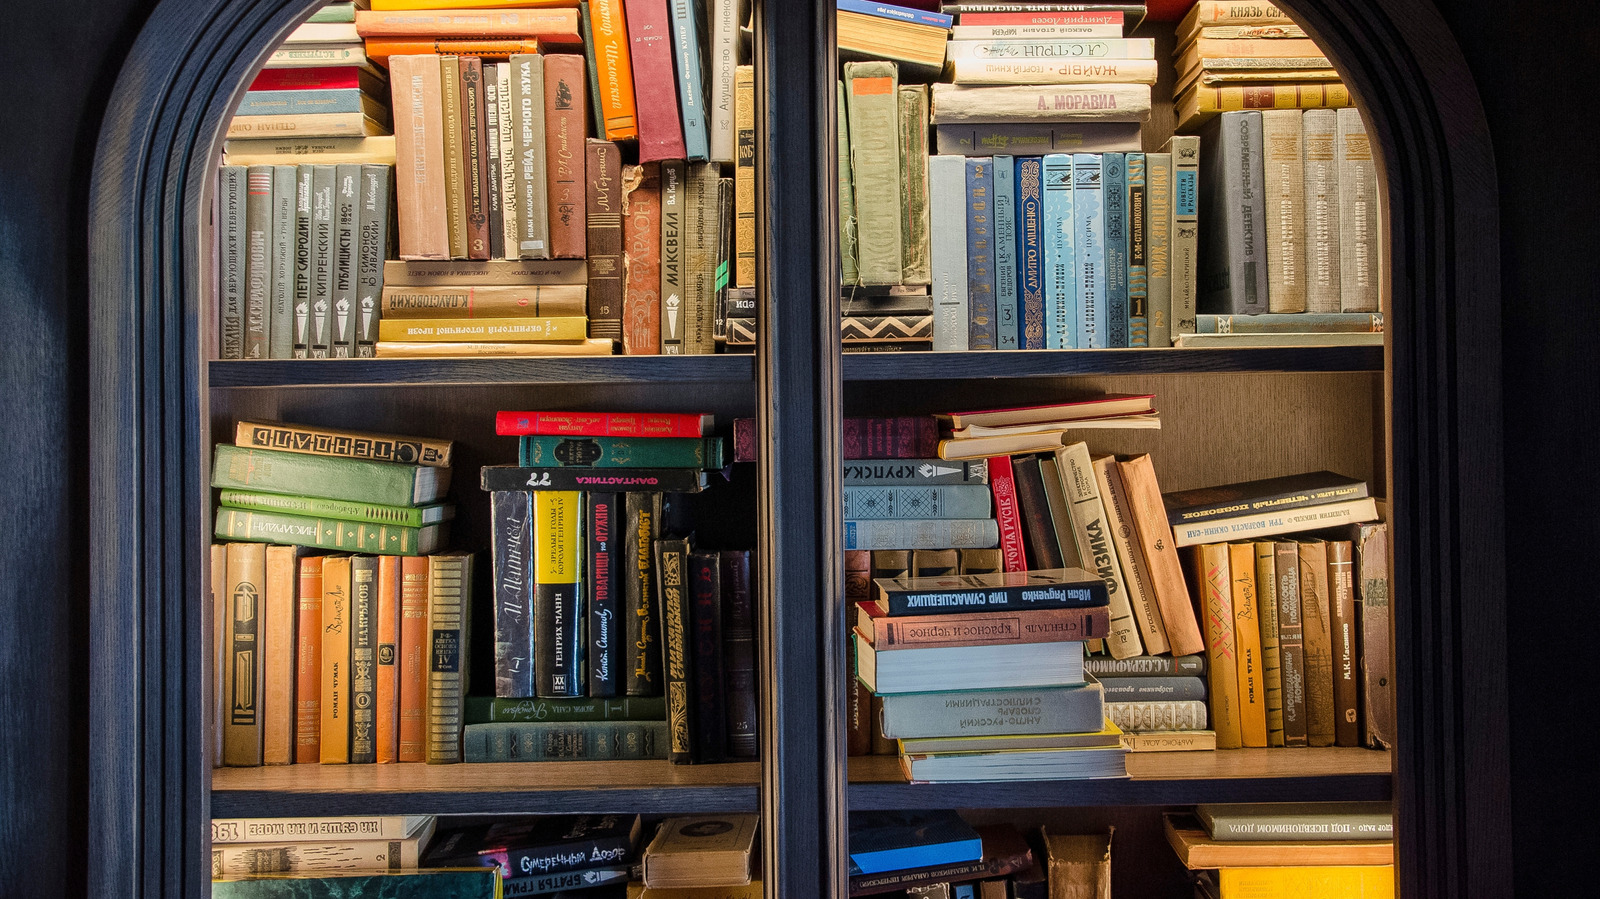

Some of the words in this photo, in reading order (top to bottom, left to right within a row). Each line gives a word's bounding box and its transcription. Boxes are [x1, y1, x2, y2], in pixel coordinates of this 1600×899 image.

[600, 0, 613, 35] иктор
[721, 0, 730, 33] гинеко
[1031, 16, 1060, 25] Лосев
[1063, 14, 1113, 25] Дмитрий
[605, 41, 622, 109] Шкловский
[985, 64, 1011, 72] КНИШ
[1058, 64, 1118, 77] ЖАЙВІР
[520, 61, 531, 95] ЖУКА
[719, 49, 731, 111] Акушерство
[500, 78, 512, 142] ПЕДАГОГІКА
[1037, 94, 1047, 111] А.
[1053, 94, 1117, 110] МОРАВИА
[522, 98, 533, 147] ЧЕРНОГО
[522, 149, 535, 179] РЕЙД
[1239, 120, 1254, 199] СОВРЕМЕННЫЙ
[229, 172, 237, 232] НЕВЕРУЮЩИХ
[526, 184, 534, 217] МАКАРОВ
[997, 199, 1006, 260] КАМЕННЫЙ
[1005, 216, 1013, 241] ПОЯС
[1026, 201, 1037, 246] МІЩЕНКО
[1151, 165, 1168, 278] МИХ.ЗОЩЕНКО
[1243, 205, 1254, 255] ДЕТЕКТИВ
[297, 217, 309, 271] СМОРОДИН
[361, 225, 370, 273] СИМОНОВ
[369, 220, 379, 273] ЗАВАДСКИЙ
[473, 239, 484, 251] 3
[633, 199, 651, 282] ФАРАОН
[666, 212, 678, 286] МАКСВЕЛЛ
[228, 242, 239, 293] ВЕРУЮЩИХ
[317, 223, 329, 296] КИПРЕНСКИЙ
[1027, 249, 1038, 288] ДМИТРО
[297, 274, 308, 299] ПЕТР
[369, 274, 378, 286] Ю.
[228, 297, 238, 314] ДЛЯ
[389, 294, 469, 311] К.ПАУСТОВСКИЙ
[599, 306, 610, 315] 15
[1136, 299, 1143, 315] 1
[1004, 309, 1012, 321] 3
[1155, 310, 1164, 328] 2
[407, 327, 433, 336] ПРОЗИ
[487, 325, 542, 335] СКРИПТОРІЙ
[253, 429, 419, 463] СТЕНДАЛЬ
[526, 472, 552, 486] 77
[575, 477, 659, 485] ФАНТАСТИКА
[1070, 458, 1083, 497] ЭЛЕКТРИЧЕСТВО
[1104, 469, 1115, 494] ВТОРОЙ
[1113, 495, 1124, 523] ВЫПУСК
[1252, 494, 1309, 509] ЧЕТВЕРТЫЙ
[1001, 498, 1013, 530] РУСІВ
[1182, 503, 1249, 519] ПОЗВОНОК
[1293, 514, 1317, 522] ПИКУЛЬ
[1319, 509, 1350, 519] ВАЛЕНТИН
[596, 504, 608, 542] ОРУЖИЮ
[1231, 520, 1265, 532] ВОЗРАСТА
[1268, 517, 1284, 526] ТРИ
[1187, 525, 1229, 538] ОКИНИ-САН
[600, 541, 607, 551] по
[1003, 532, 1021, 571] СТОРІЯ
[1124, 541, 1136, 564] ПОЭТЫ
[1086, 518, 1118, 595] ФИЗИКА
[596, 552, 609, 600] ТОВАРИЩИ
[1132, 565, 1147, 602] СОВЕТСКИЕ
[907, 592, 986, 608] СУМАСШЕДШИХ
[989, 591, 1008, 604] ПИР
[1021, 587, 1066, 602] Рядченко
[1067, 588, 1091, 601] Иван
[358, 584, 369, 646] И.А.КРЫЛОВ
[1143, 603, 1157, 634] РУССКИЕ
[596, 609, 612, 648] Симонов
[665, 588, 678, 679] МИХАЙЛО
[672, 587, 684, 679] СТАРИЦЬКИЙ
[909, 626, 951, 639] черное
[953, 626, 961, 637] и
[963, 624, 1012, 638] красное
[1025, 621, 1077, 633] СТЕНДАЛЬ
[555, 626, 563, 667] ГЕНРИХ
[1342, 623, 1350, 660] Касвинов
[439, 655, 451, 664] IV
[573, 705, 595, 713] ЖОРЖ
[945, 698, 1032, 708] ИЛЛЮСТРАЦИЯМИ
[1034, 697, 1041, 706] С
[997, 707, 1041, 716] СЛОВАРЬ
[959, 715, 1041, 729] АНГЛО-РУССКИЙ
[249, 824, 284, 835] МОРЕ
[287, 823, 305, 834] НА
[308, 824, 318, 834] И
[321, 822, 358, 834] СУШЕ
[360, 821, 378, 833] НА
[1229, 824, 1255, 833] ДОРА
[1256, 824, 1329, 833] ПСЕВДОНИМОМ
[1330, 824, 1350, 833] ПОД
[520, 850, 586, 874] Сумеречный
[589, 845, 626, 862] Дозор
